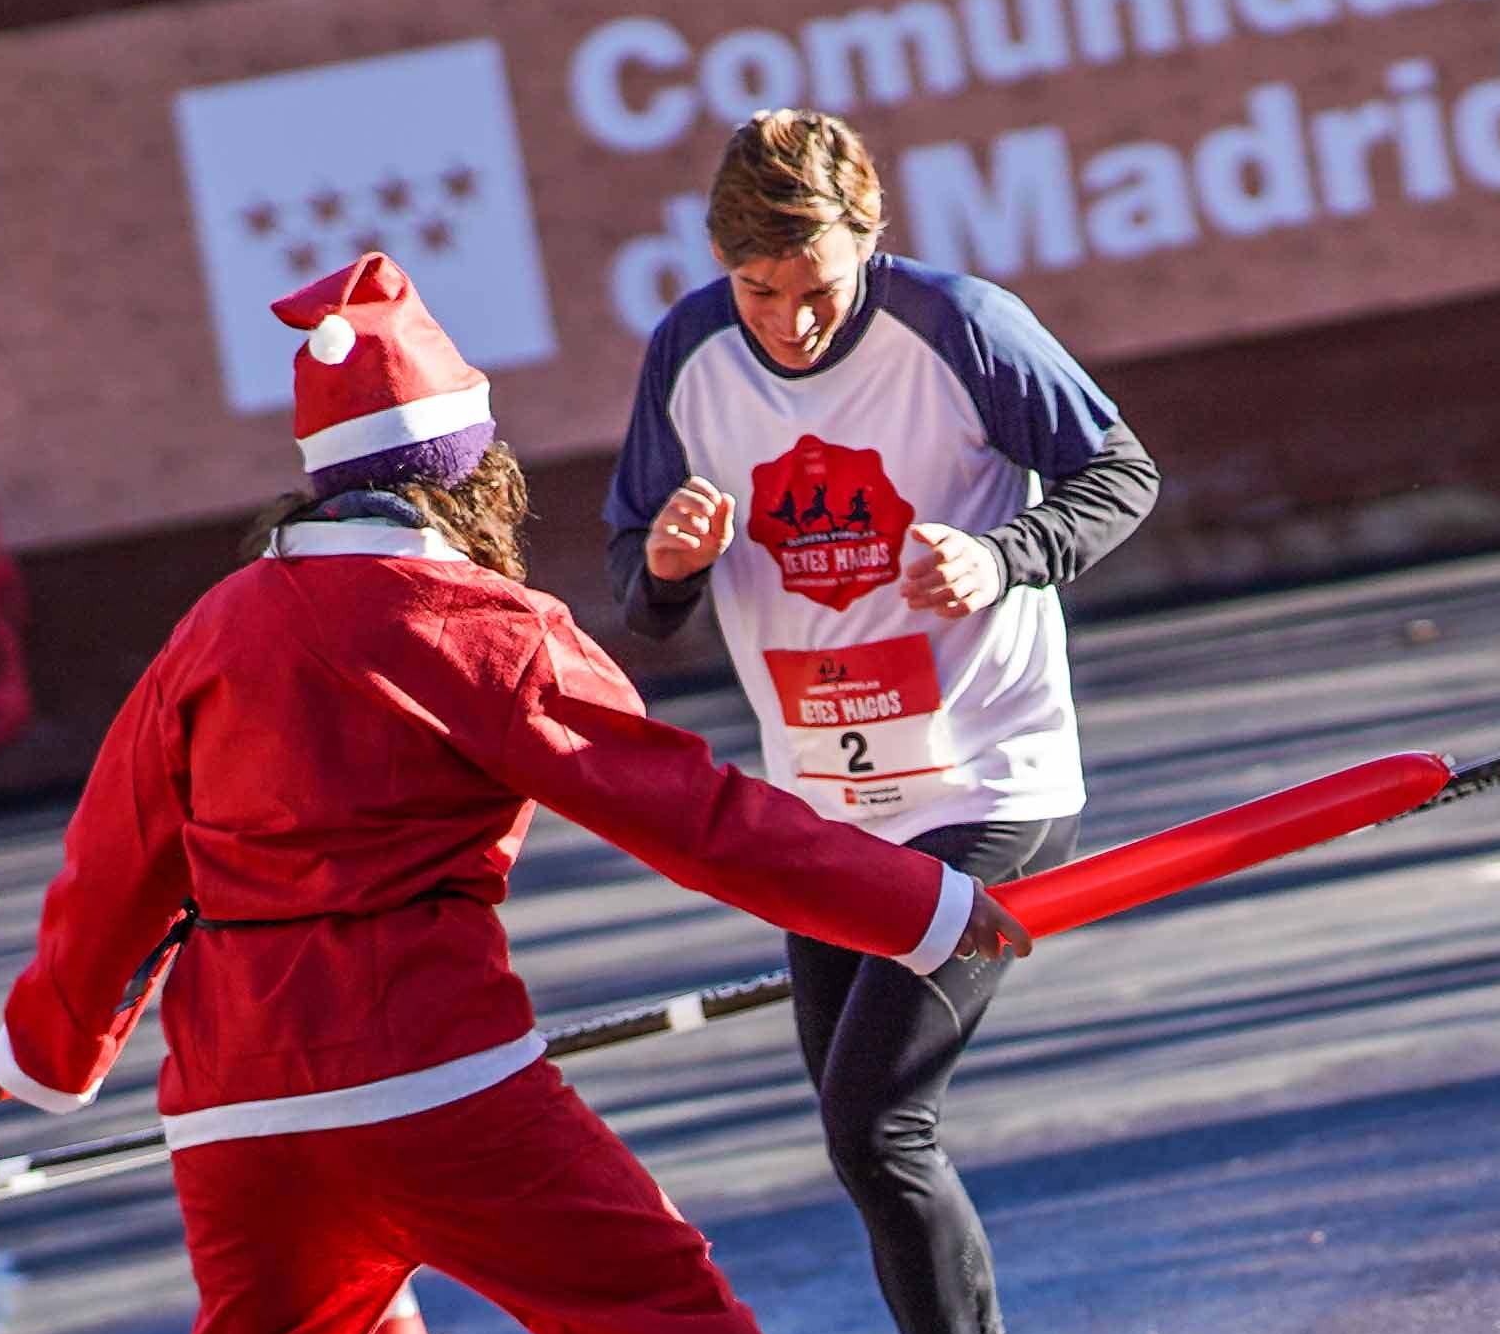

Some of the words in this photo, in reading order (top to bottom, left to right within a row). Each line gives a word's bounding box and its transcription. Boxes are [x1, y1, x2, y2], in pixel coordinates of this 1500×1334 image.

[834, 542, 890, 572] MAGOS
[840, 689, 902, 722] MAGOS
[840, 731, 874, 773] 2
